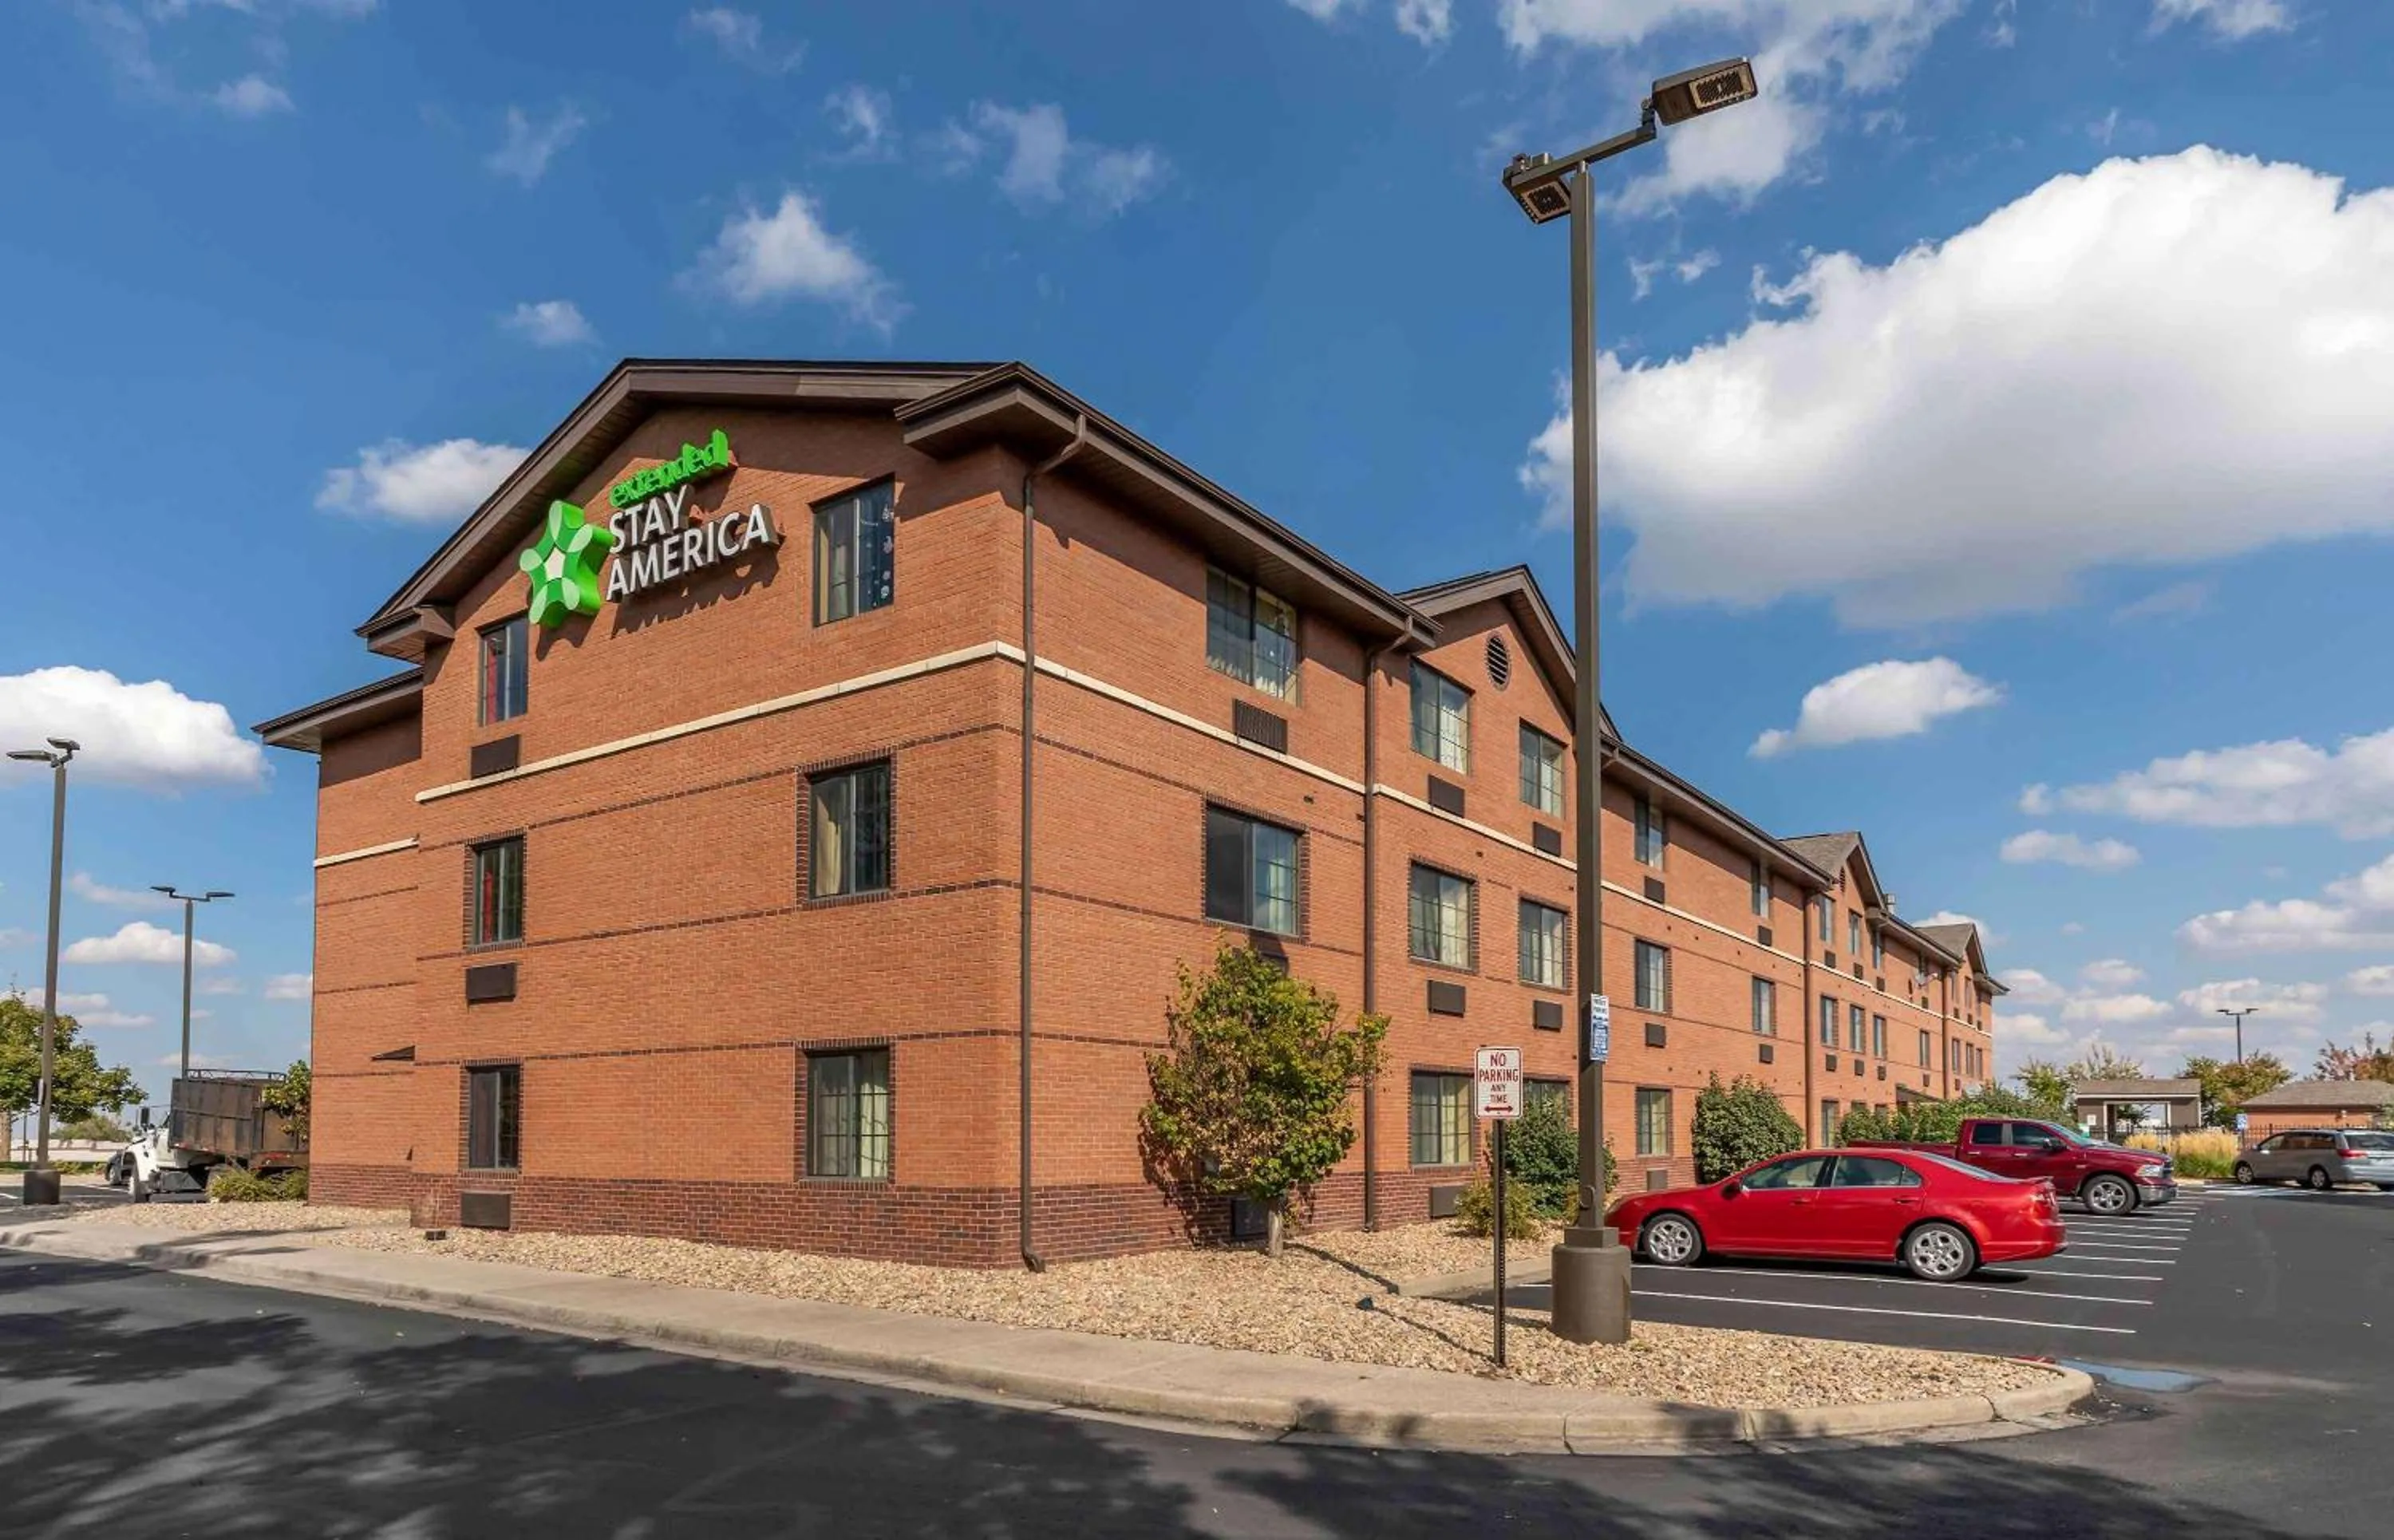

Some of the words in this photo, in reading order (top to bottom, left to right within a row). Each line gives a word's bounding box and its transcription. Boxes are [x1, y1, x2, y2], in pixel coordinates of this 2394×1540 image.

[609, 428, 729, 507] extended
[608, 484, 693, 555] STAY
[606, 503, 775, 602] AMERICA
[1490, 1052, 1507, 1067] NO
[1479, 1068, 1519, 1083] PARKING
[1490, 1084, 1507, 1092] ANY
[1490, 1094, 1507, 1104] TIME
